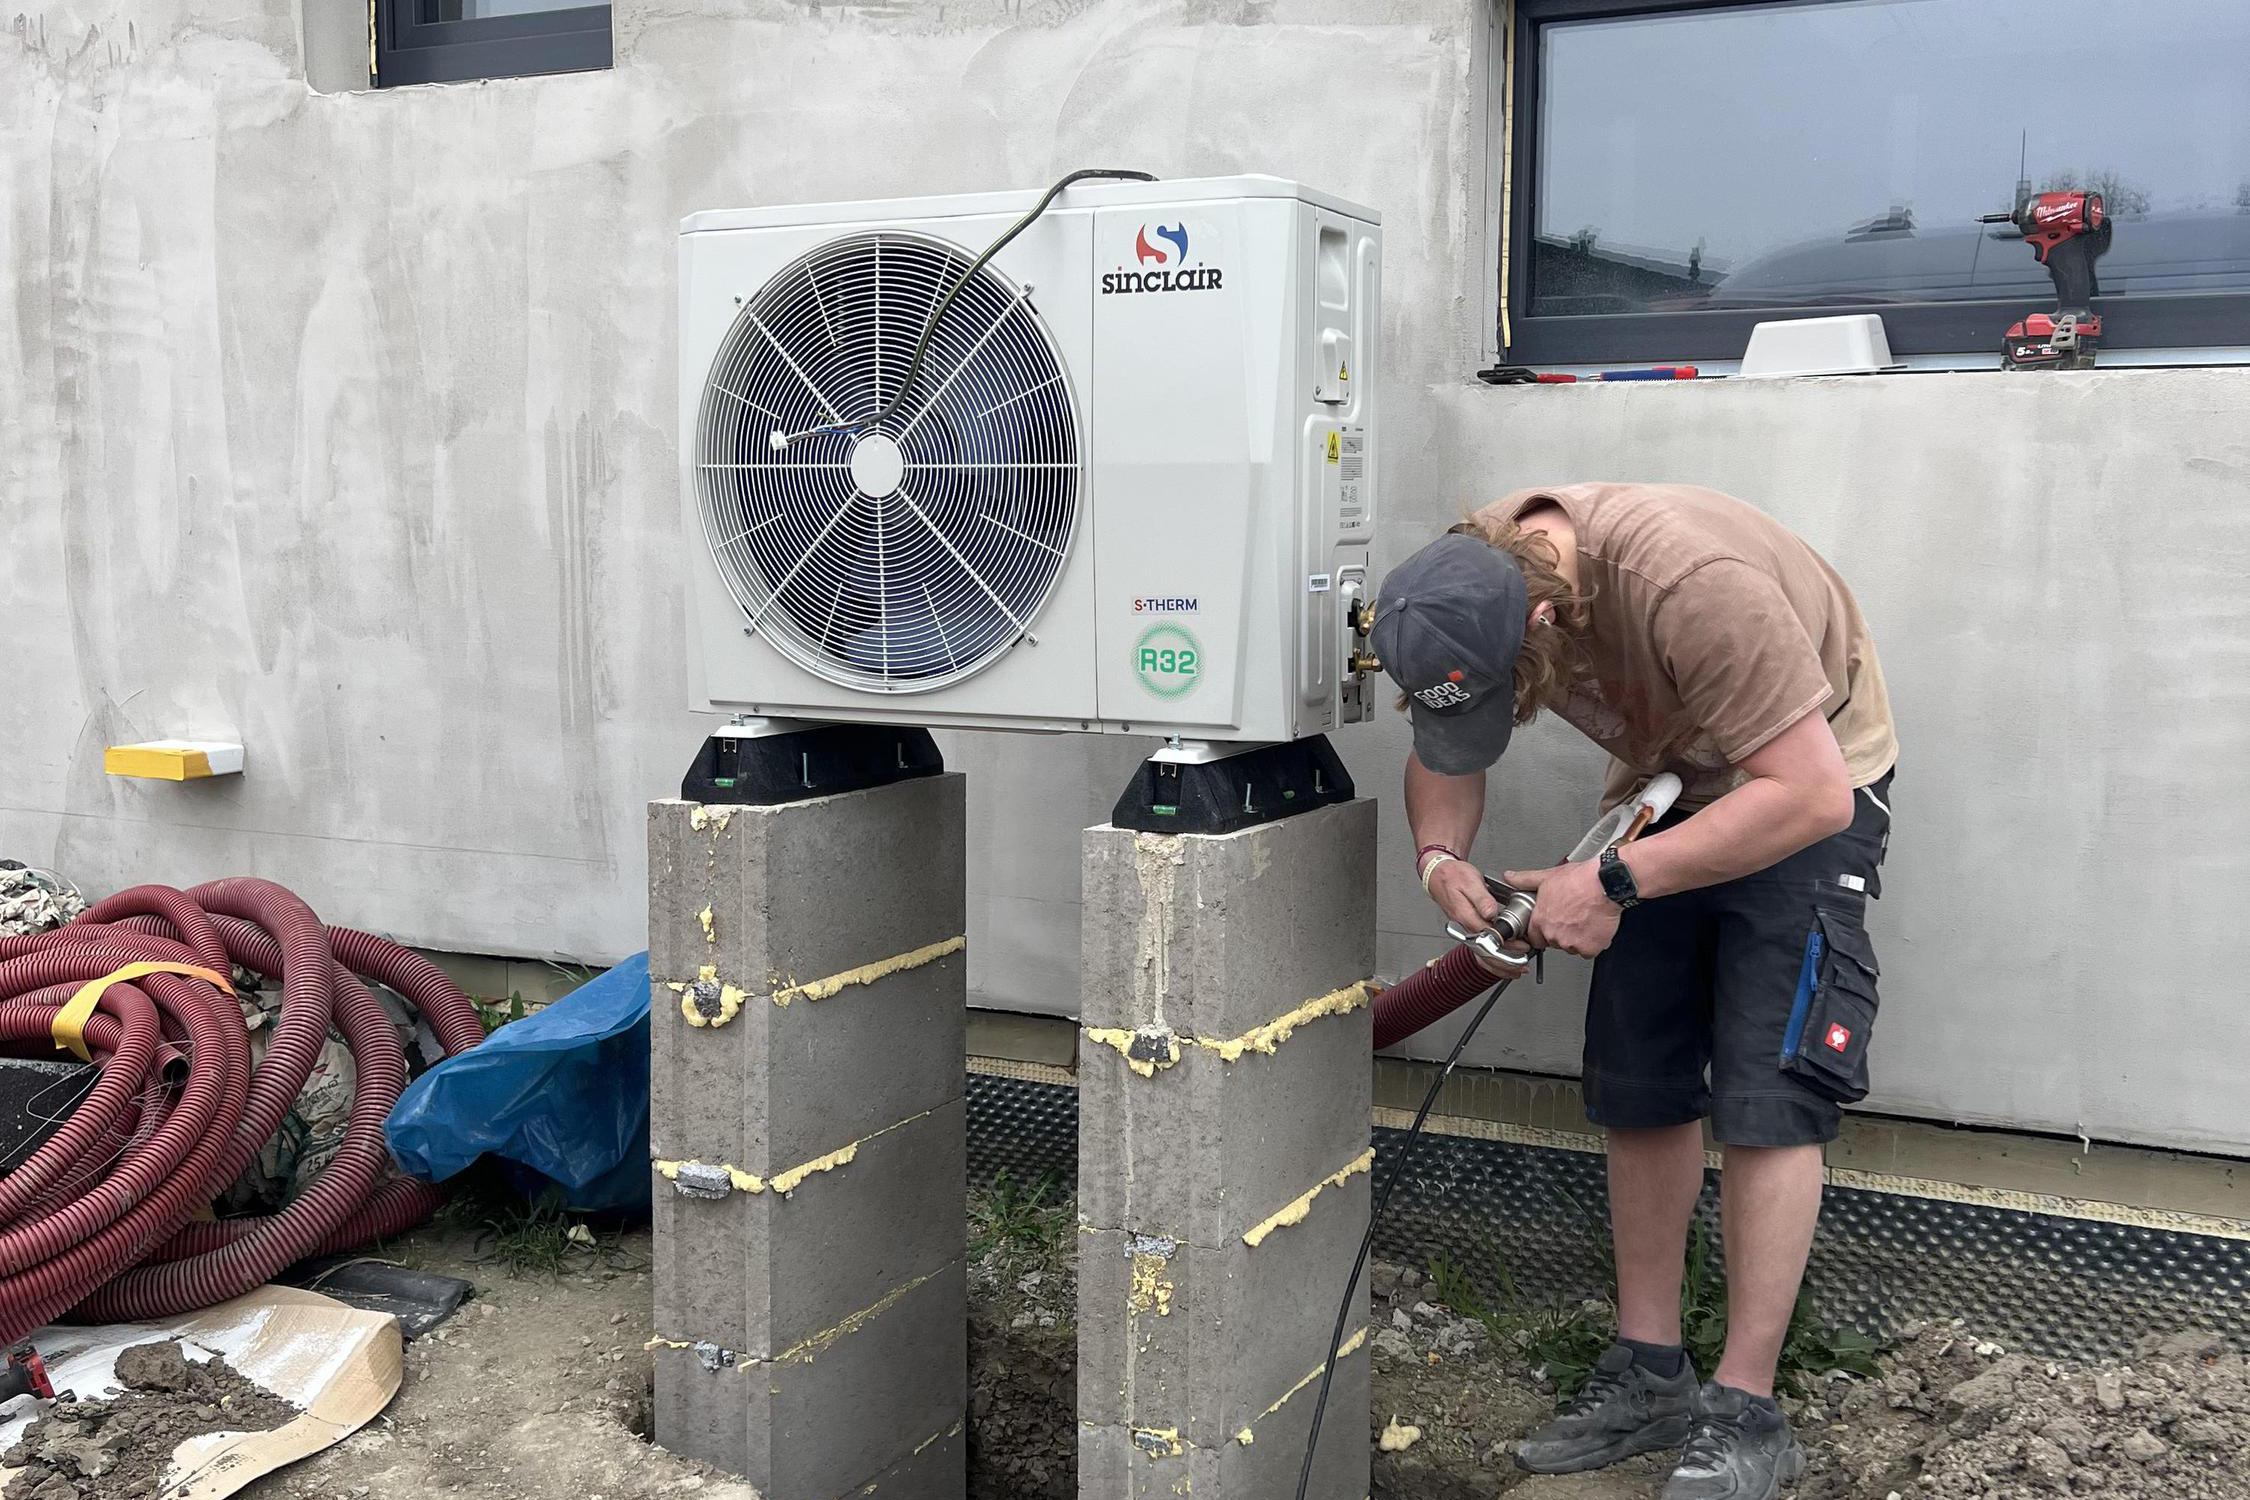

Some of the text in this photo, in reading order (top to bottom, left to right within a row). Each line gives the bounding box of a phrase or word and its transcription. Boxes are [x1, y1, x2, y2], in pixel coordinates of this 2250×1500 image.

[1140, 648, 1196, 674] R32
[1413, 681, 1460, 701] GOOD
[1423, 689, 1471, 709] IDEAS
[307, 1156, 321, 1173] 25
